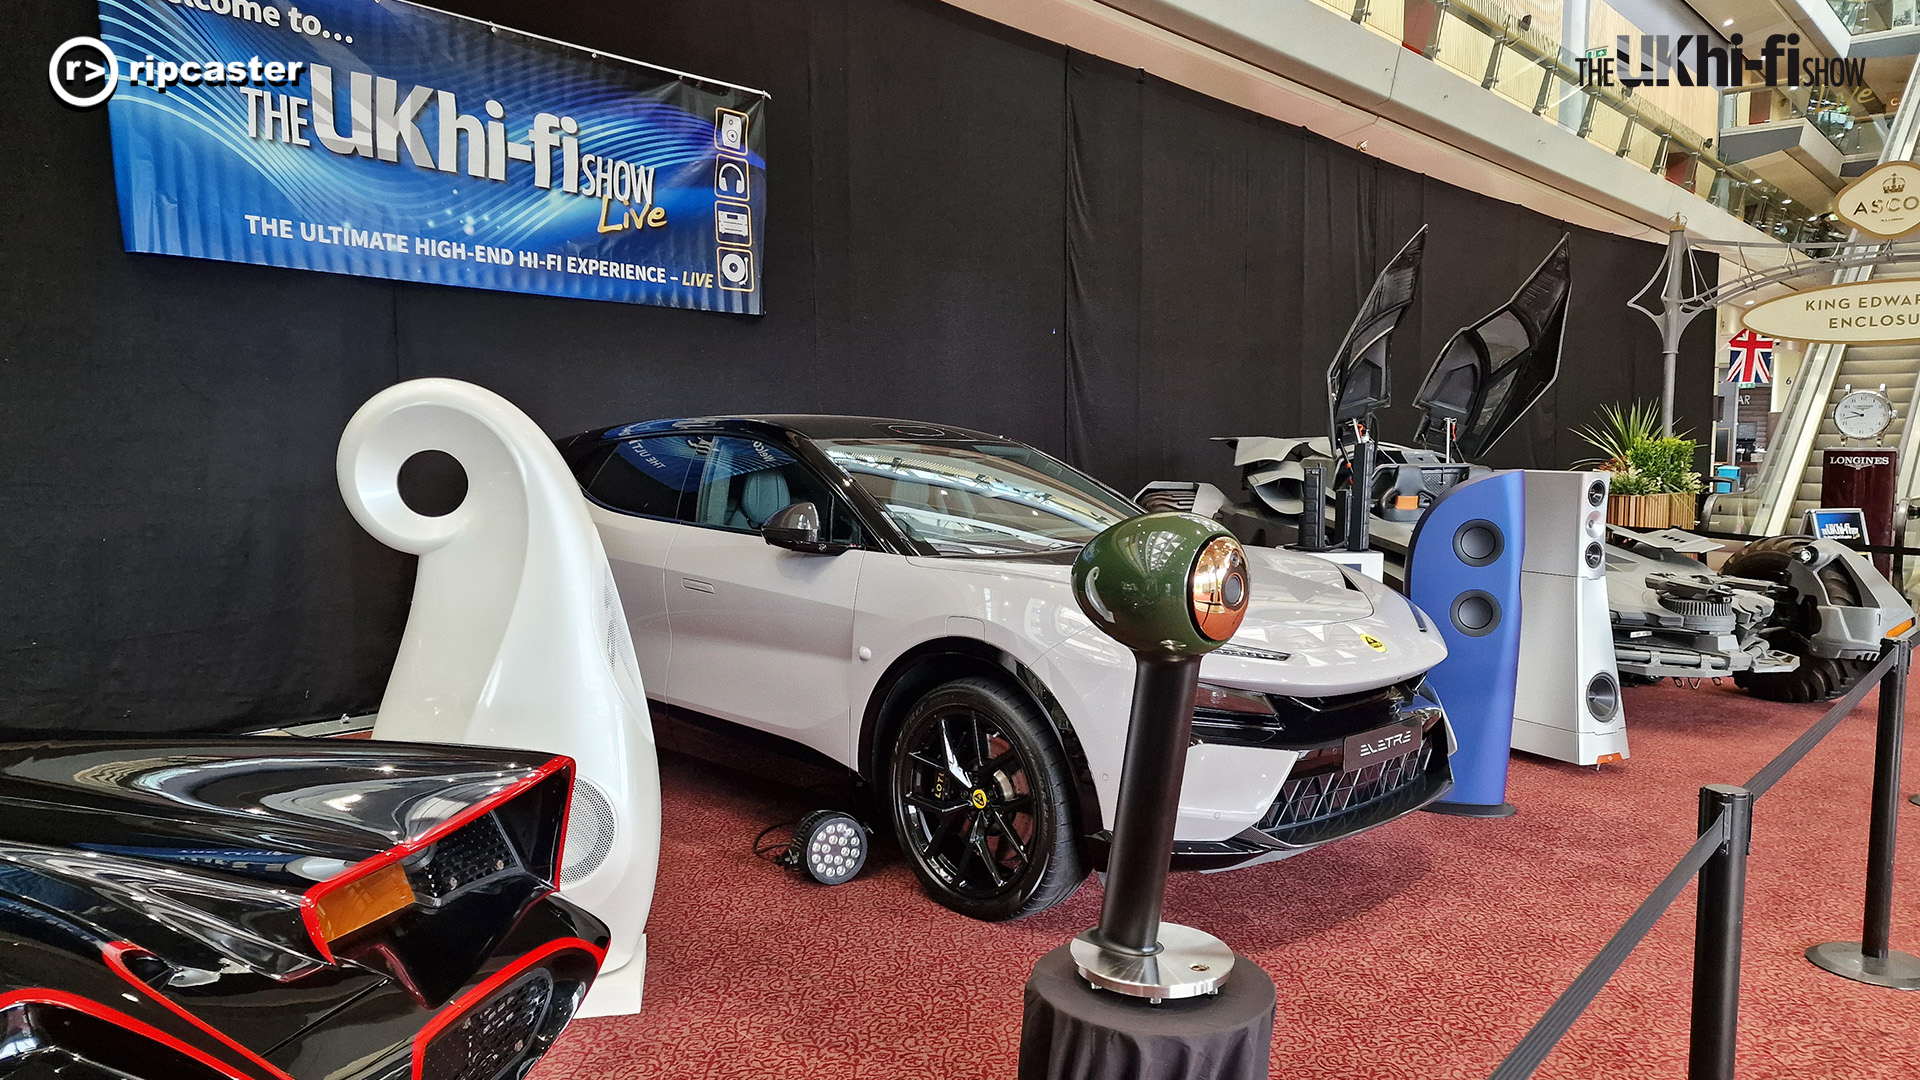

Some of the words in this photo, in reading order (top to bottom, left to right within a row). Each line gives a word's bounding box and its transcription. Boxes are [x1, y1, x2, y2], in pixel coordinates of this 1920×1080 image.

[239, 86, 311, 147] THE
[581, 153, 655, 205] SHOW
[597, 194, 668, 234] Live
[244, 214, 294, 239] THE
[299, 222, 410, 254] ULTIMATE
[415, 237, 515, 266] HIGH-END
[518, 250, 562, 272] HI-FI
[566, 256, 667, 284] EXPERIENCE
[682, 271, 715, 289] LIVE
[1805, 297, 1850, 312] KING
[1829, 313, 1920, 329] ENCLOSU
[1829, 456, 1890, 465] LONGINES
[1360, 730, 1412, 757] ELETRE
